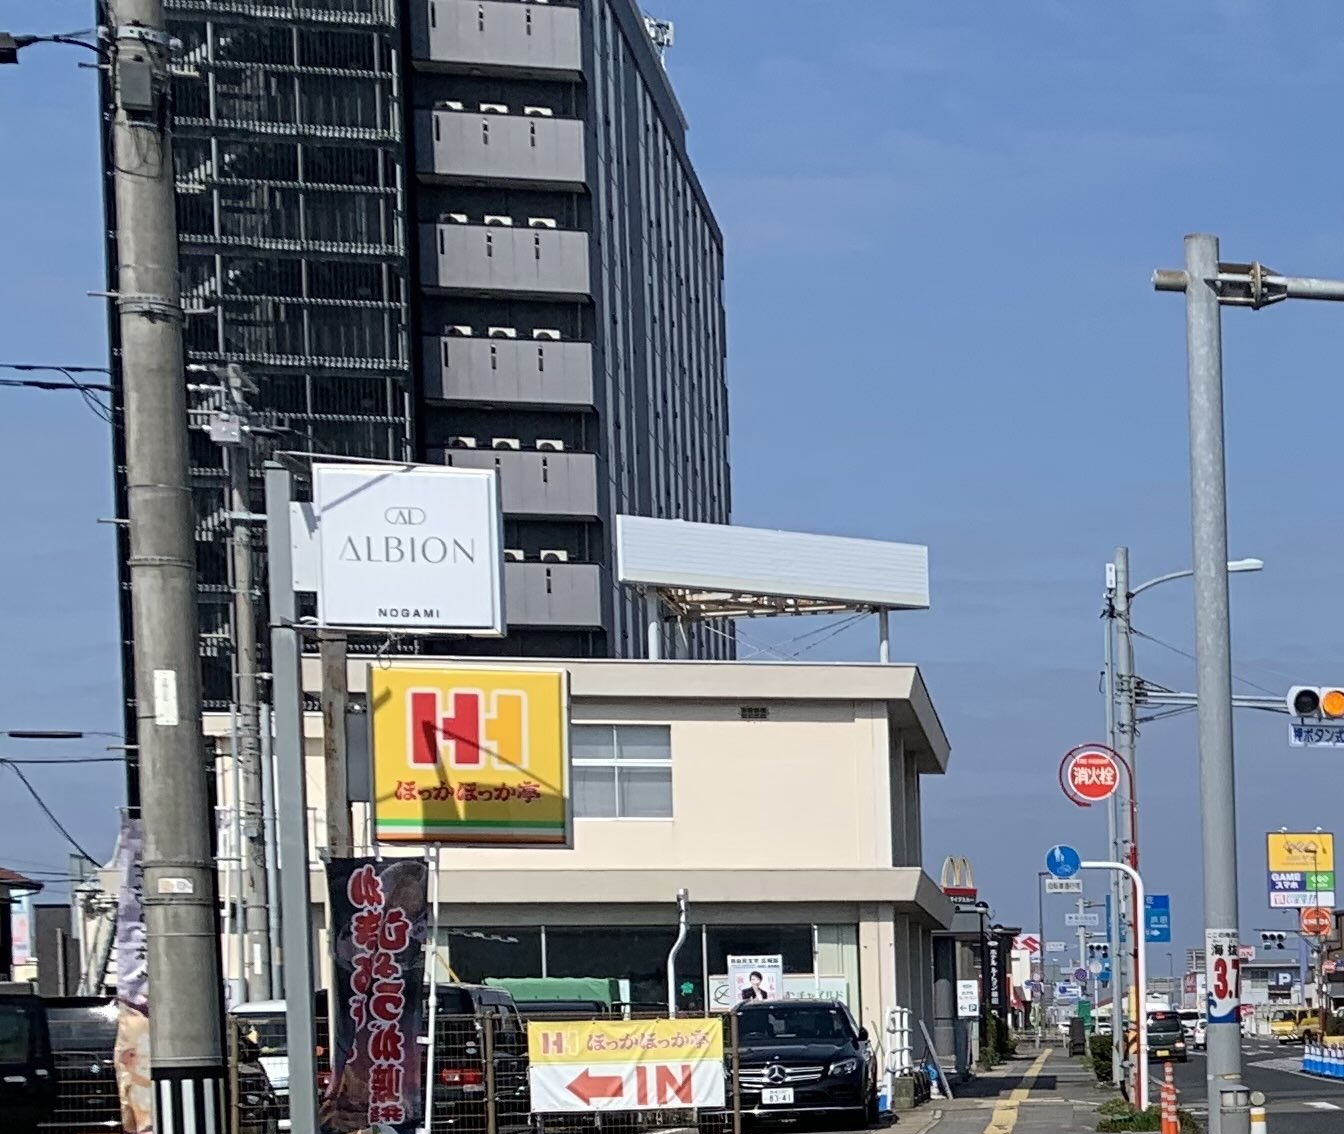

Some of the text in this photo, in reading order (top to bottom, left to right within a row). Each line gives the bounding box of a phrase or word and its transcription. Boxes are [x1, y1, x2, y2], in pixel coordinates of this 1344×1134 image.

[339, 536, 475, 564] ALBION
[378, 608, 440, 618] NOGAMI
[1073, 766, 1114, 786] 消火栓
[394, 780, 541, 803] ほっかほっか亭
[1279, 973, 1291, 985] P
[636, 1064, 693, 1105] IN
